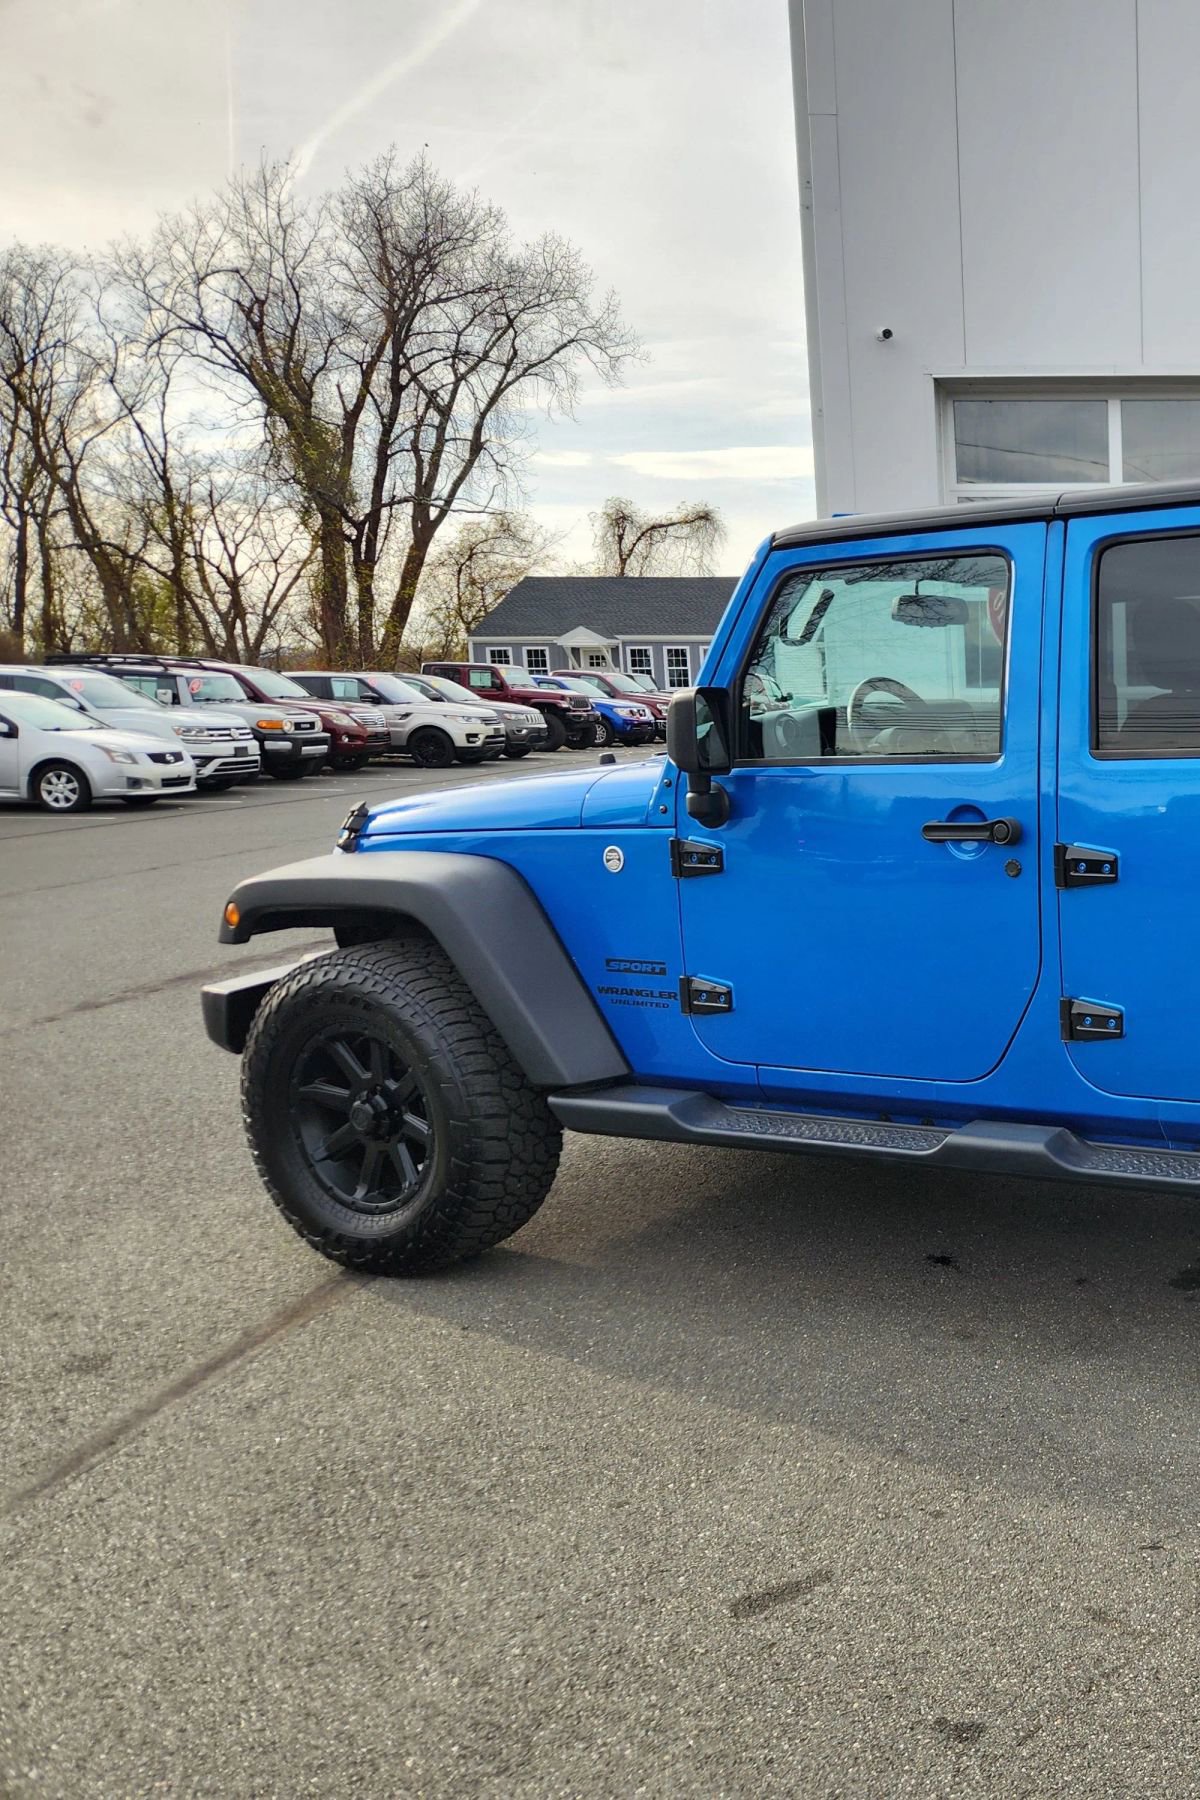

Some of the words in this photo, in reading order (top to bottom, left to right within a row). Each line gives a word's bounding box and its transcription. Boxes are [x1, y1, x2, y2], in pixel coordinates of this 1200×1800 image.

[607, 960, 663, 974] SPORT
[597, 986, 679, 1001] WRANGLER
[610, 999, 669, 1009] UNLIMITED
